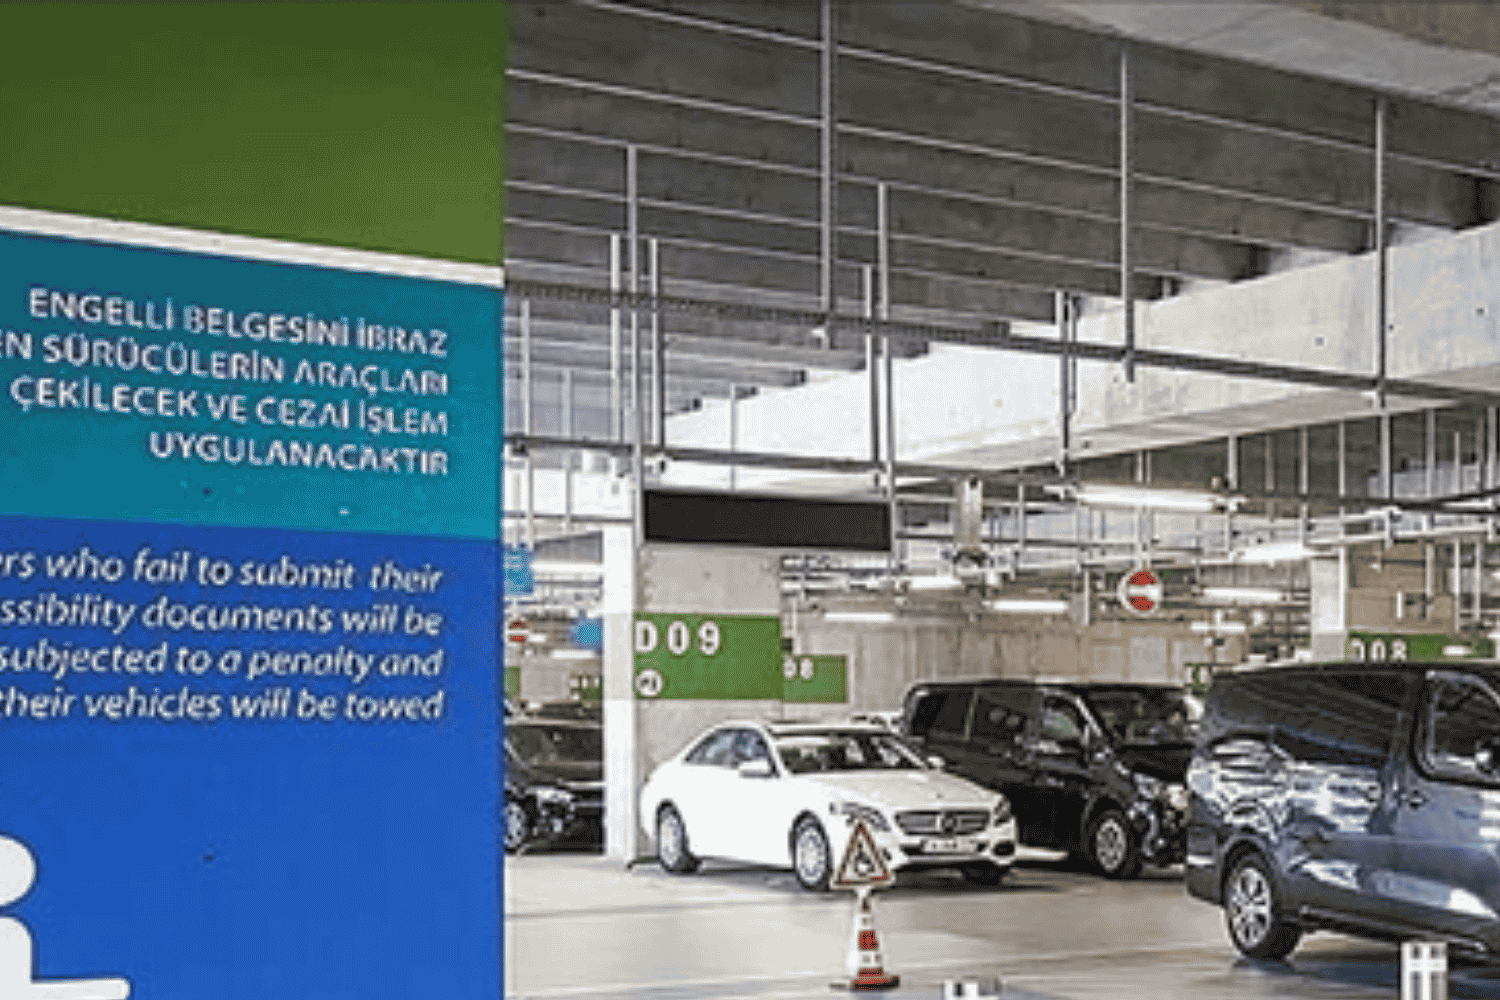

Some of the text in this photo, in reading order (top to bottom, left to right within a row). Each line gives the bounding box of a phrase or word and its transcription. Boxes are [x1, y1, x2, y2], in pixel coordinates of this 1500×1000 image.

[29, 288, 448, 358] ENGELLİ BELGESİNİ İBRAZ
[0, 329, 448, 399] N SÜRÜCÜLERİN ARAÇLARI
[9, 374, 198, 417] ÇEKİLECEK
[204, 392, 247, 424] VE
[150, 431, 448, 477] UYGULANACAKTIR
[0, 547, 443, 593] rs who fail to submit their
[143, 596, 332, 633] documents
[342, 604, 398, 632] will
[405, 605, 443, 635] be
[177, 646, 212, 675] to
[219, 650, 241, 675] a
[246, 645, 373, 684] penalty
[380, 649, 443, 676] and
[84, 686, 222, 720] vehicles
[231, 687, 291, 718] will
[298, 688, 337, 720] be
[346, 689, 444, 721] towed
